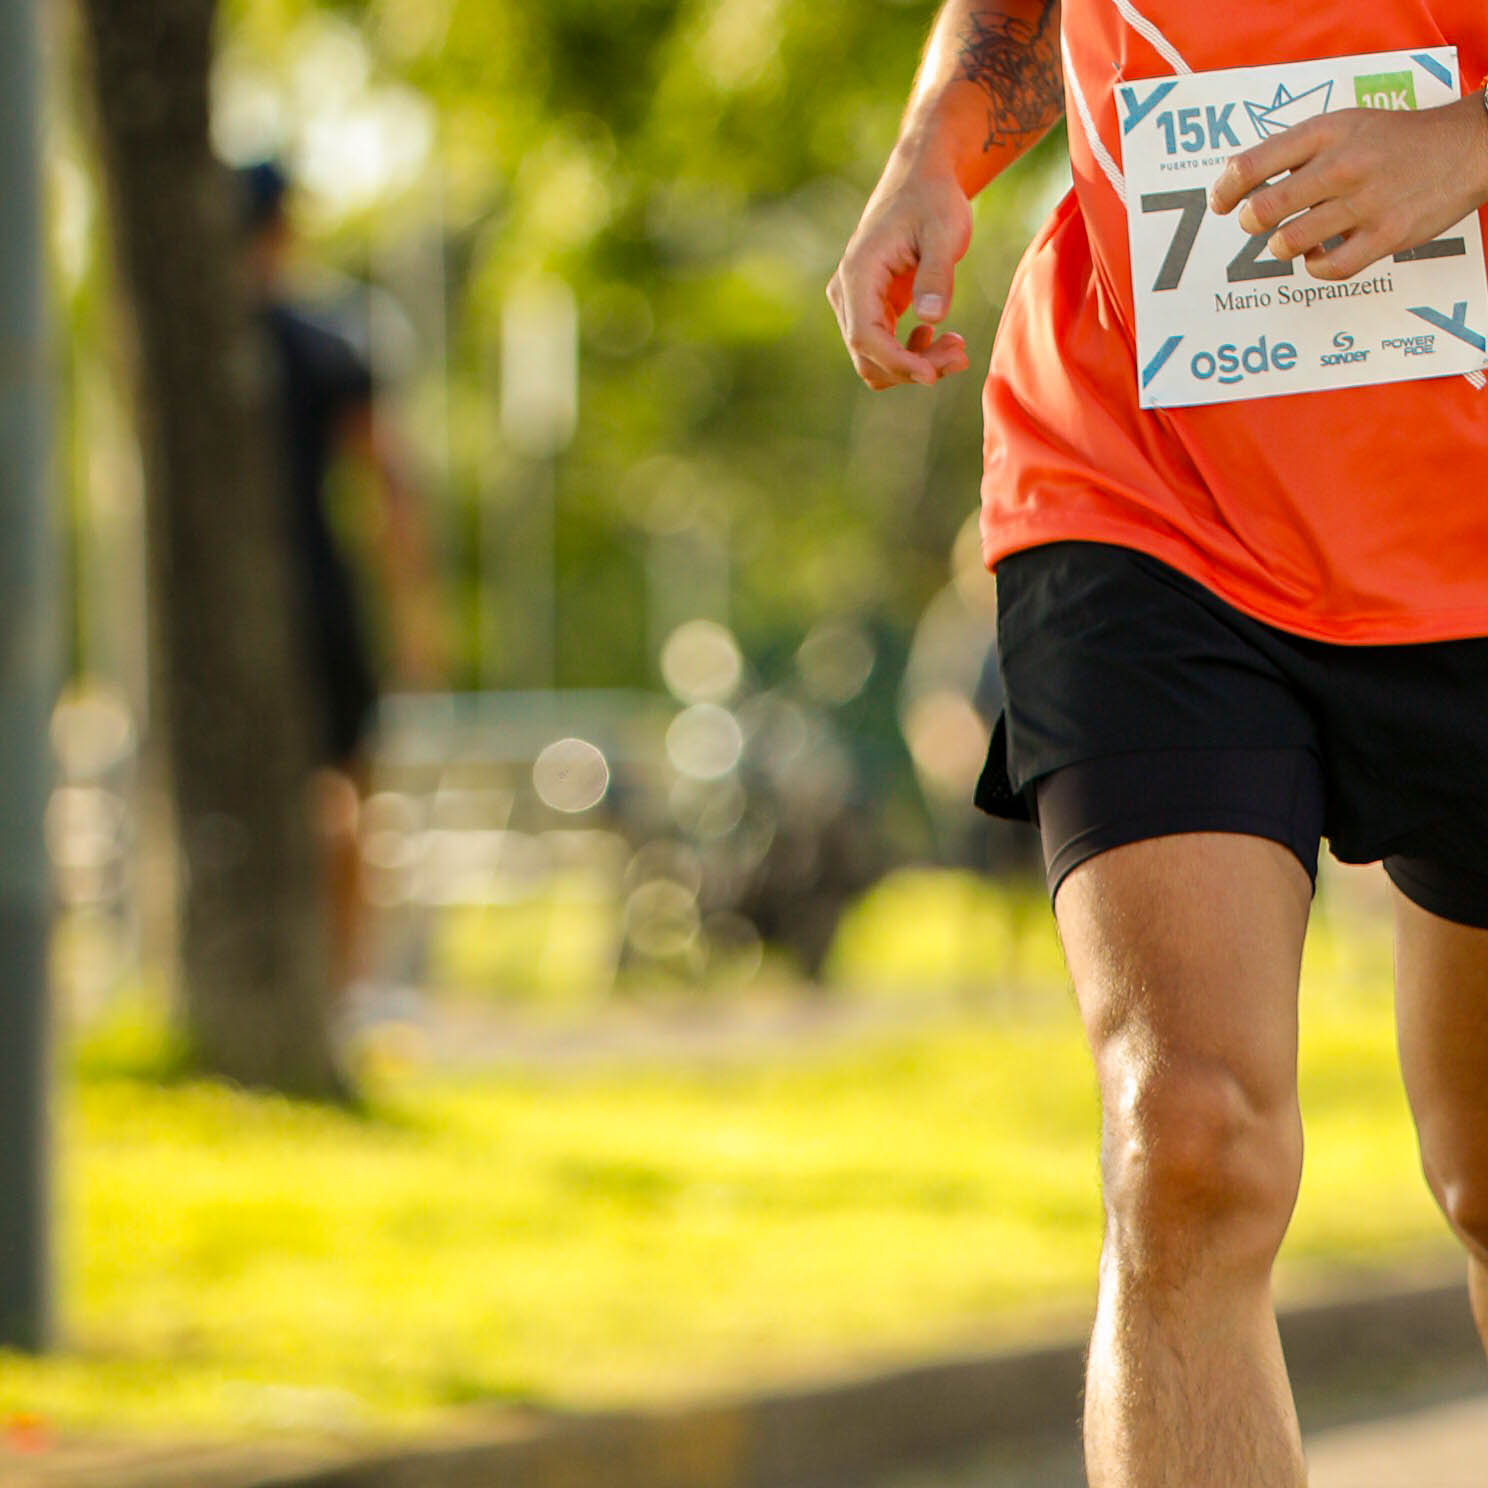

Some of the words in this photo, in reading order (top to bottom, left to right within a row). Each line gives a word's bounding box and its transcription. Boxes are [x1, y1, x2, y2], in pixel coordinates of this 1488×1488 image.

[1156, 101, 1242, 155] 15K
[1160, 159, 1199, 171] PUERTO
[1201, 155, 1226, 167] NORT
[1214, 287, 1272, 312] Mario
[1277, 273, 1394, 307] Sopranzetti
[1190, 335, 1298, 382] osde
